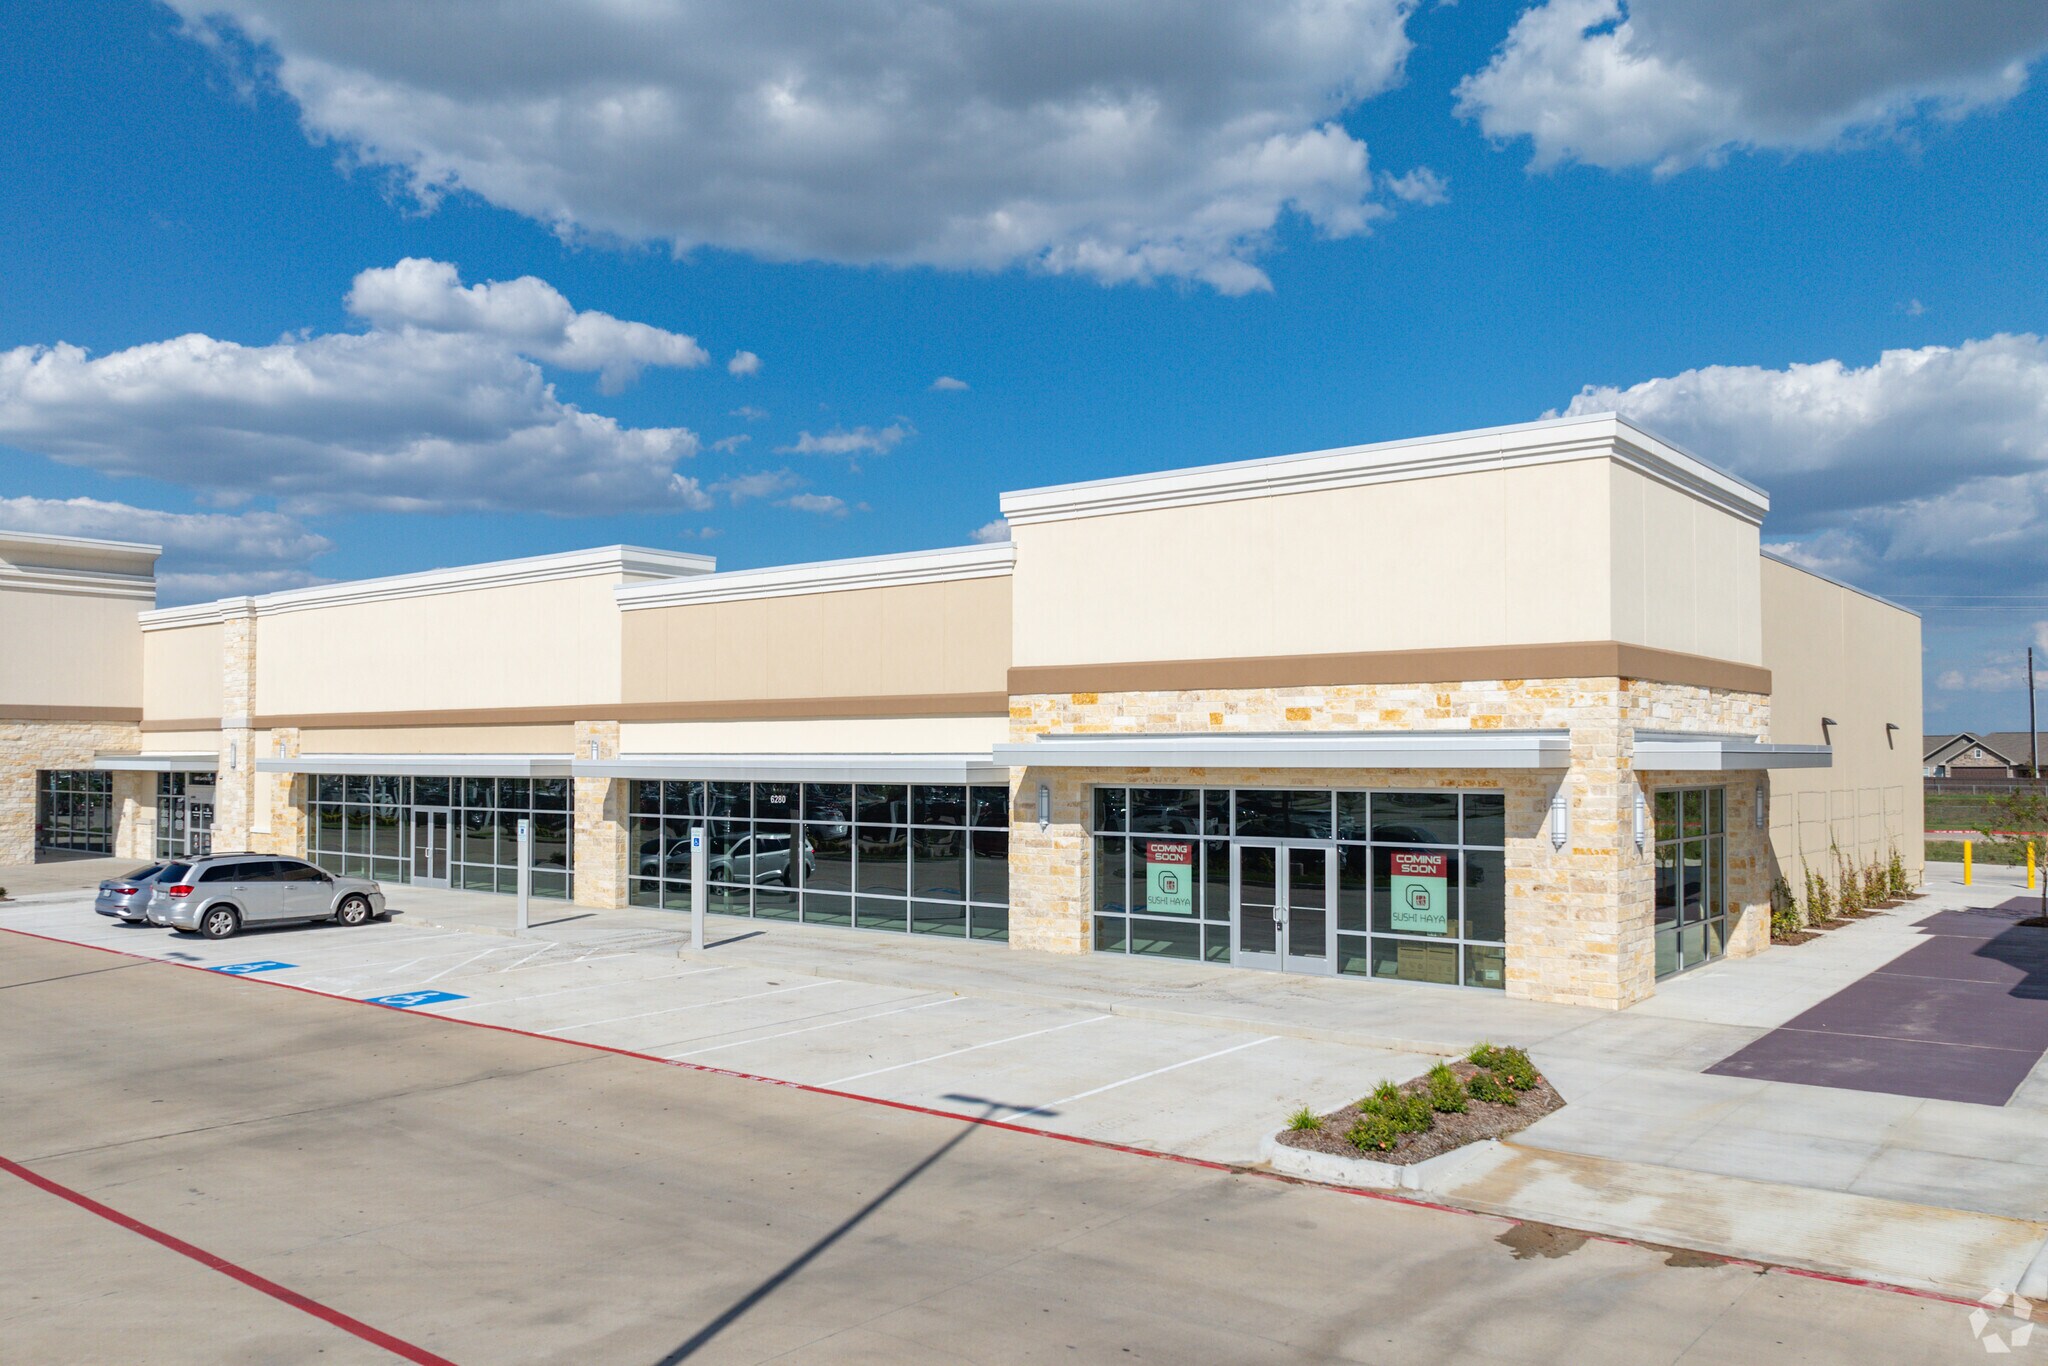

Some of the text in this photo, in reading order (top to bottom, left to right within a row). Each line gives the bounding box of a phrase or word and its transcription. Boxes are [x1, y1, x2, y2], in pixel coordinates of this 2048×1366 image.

[1151, 844, 1187, 853] COMING
[1155, 853, 1184, 861] SOON
[1396, 854, 1442, 864] COMING
[1401, 864, 1436, 873] SOON
[1148, 896, 1190, 906] SUSHI HAYA
[1393, 912, 1446, 924] SUSHI HAYA
